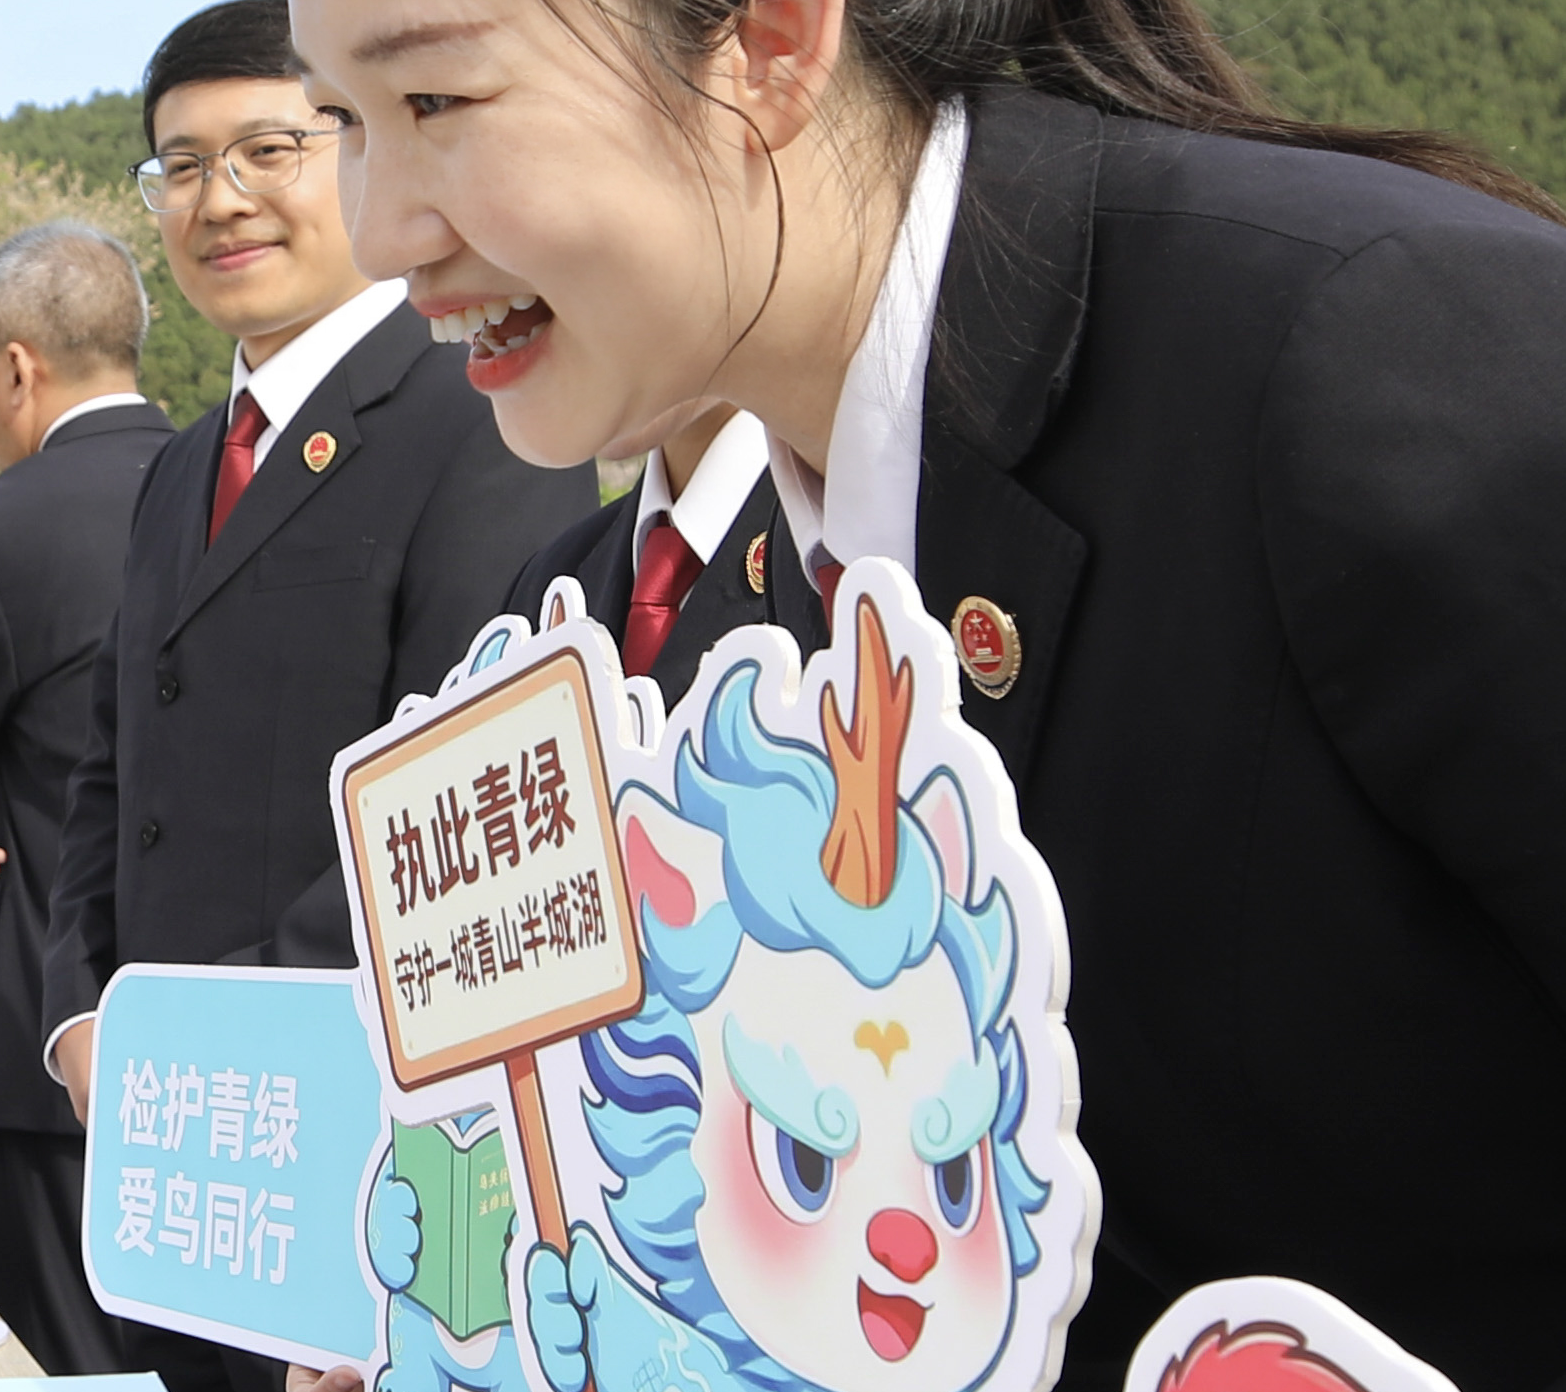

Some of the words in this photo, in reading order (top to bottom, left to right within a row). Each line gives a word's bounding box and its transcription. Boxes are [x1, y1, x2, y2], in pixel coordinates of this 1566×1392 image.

[386, 736, 576, 918] 执此青绿
[394, 868, 607, 1012] 守护一城青山半城湖
[118, 1057, 300, 1169] 检护青绿
[114, 1166, 296, 1285] 爱鸟同行
